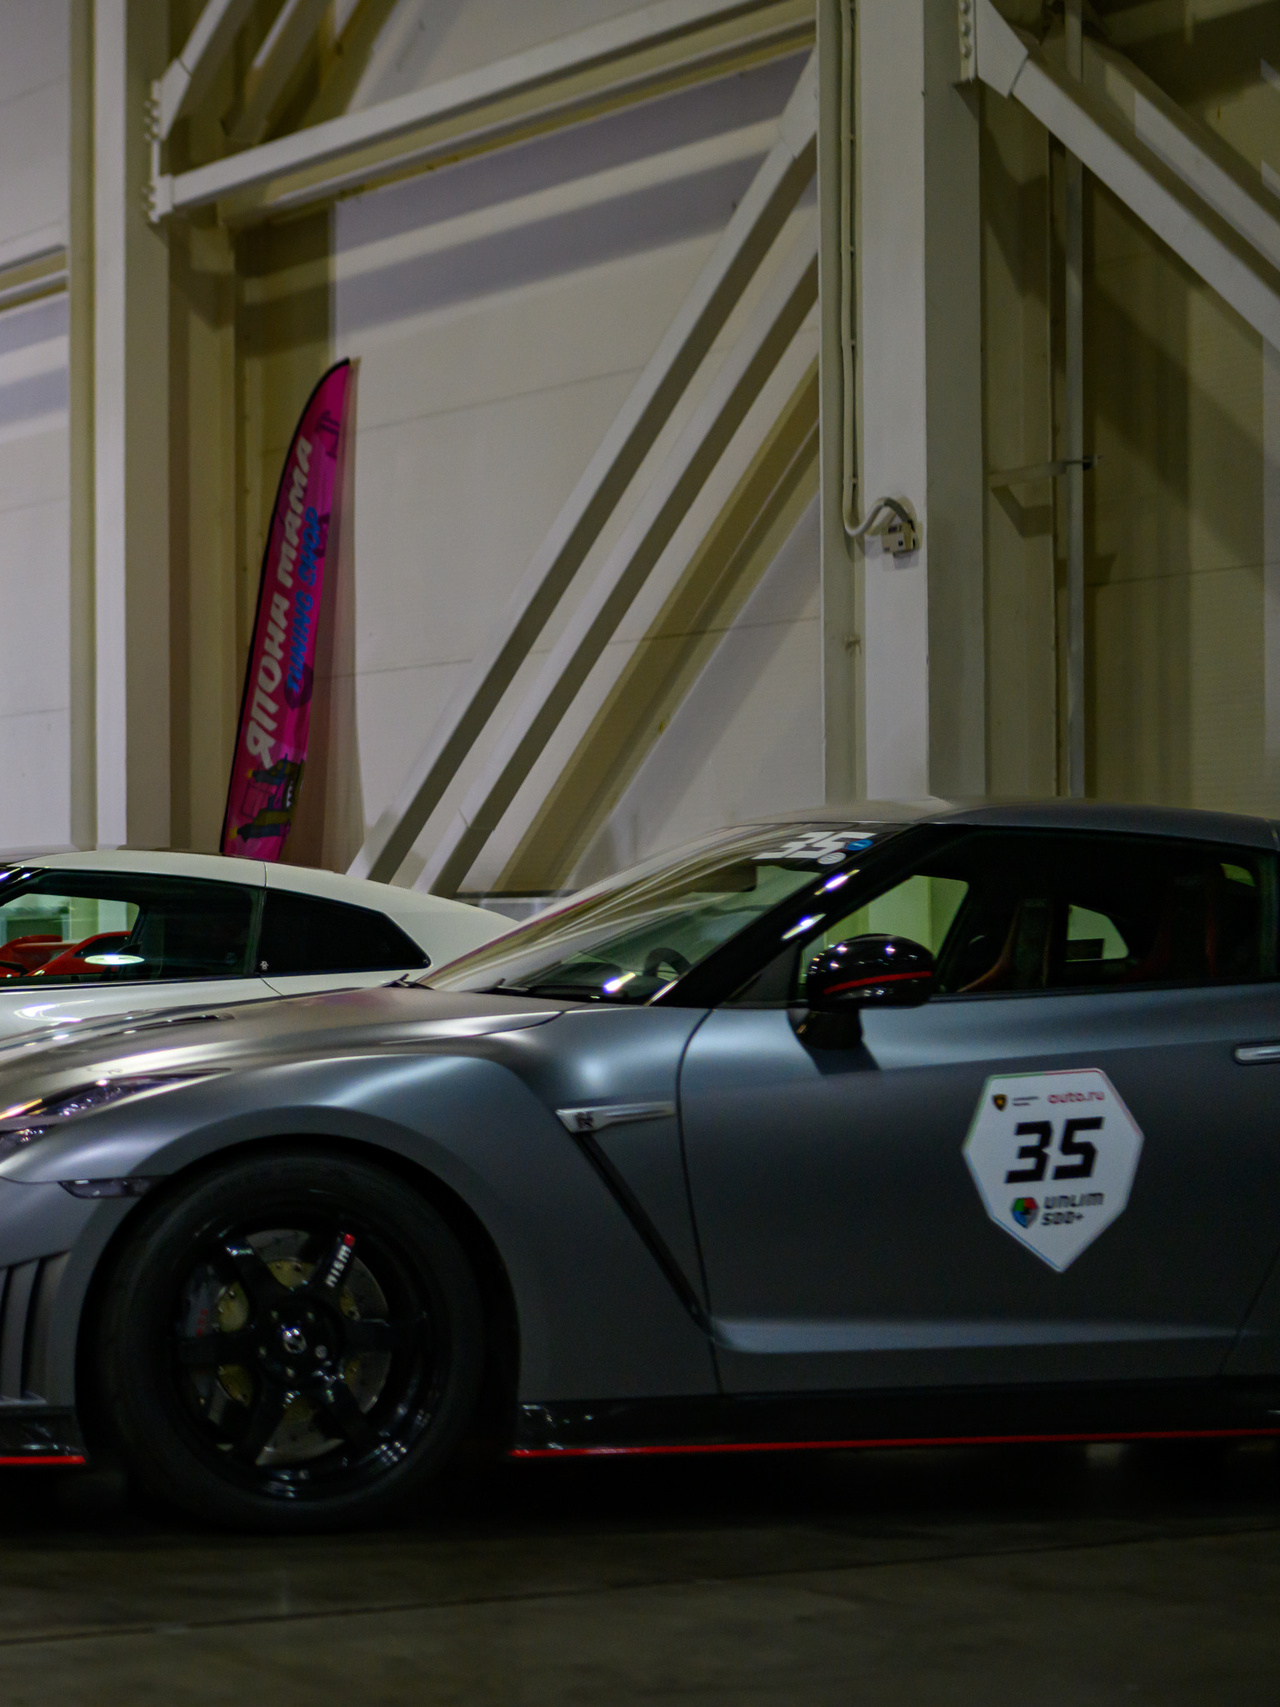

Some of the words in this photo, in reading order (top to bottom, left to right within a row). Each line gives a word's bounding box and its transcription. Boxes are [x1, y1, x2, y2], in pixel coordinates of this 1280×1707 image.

[298, 507, 320, 586] SHOP
[246, 592, 291, 769] ЯПОНА
[276, 436, 312, 588] МАМА
[287, 590, 314, 693] TUNING
[751, 831, 877, 860] 35
[1048, 1091, 1106, 1104] auto.ru
[1004, 1116, 1105, 1184] 35
